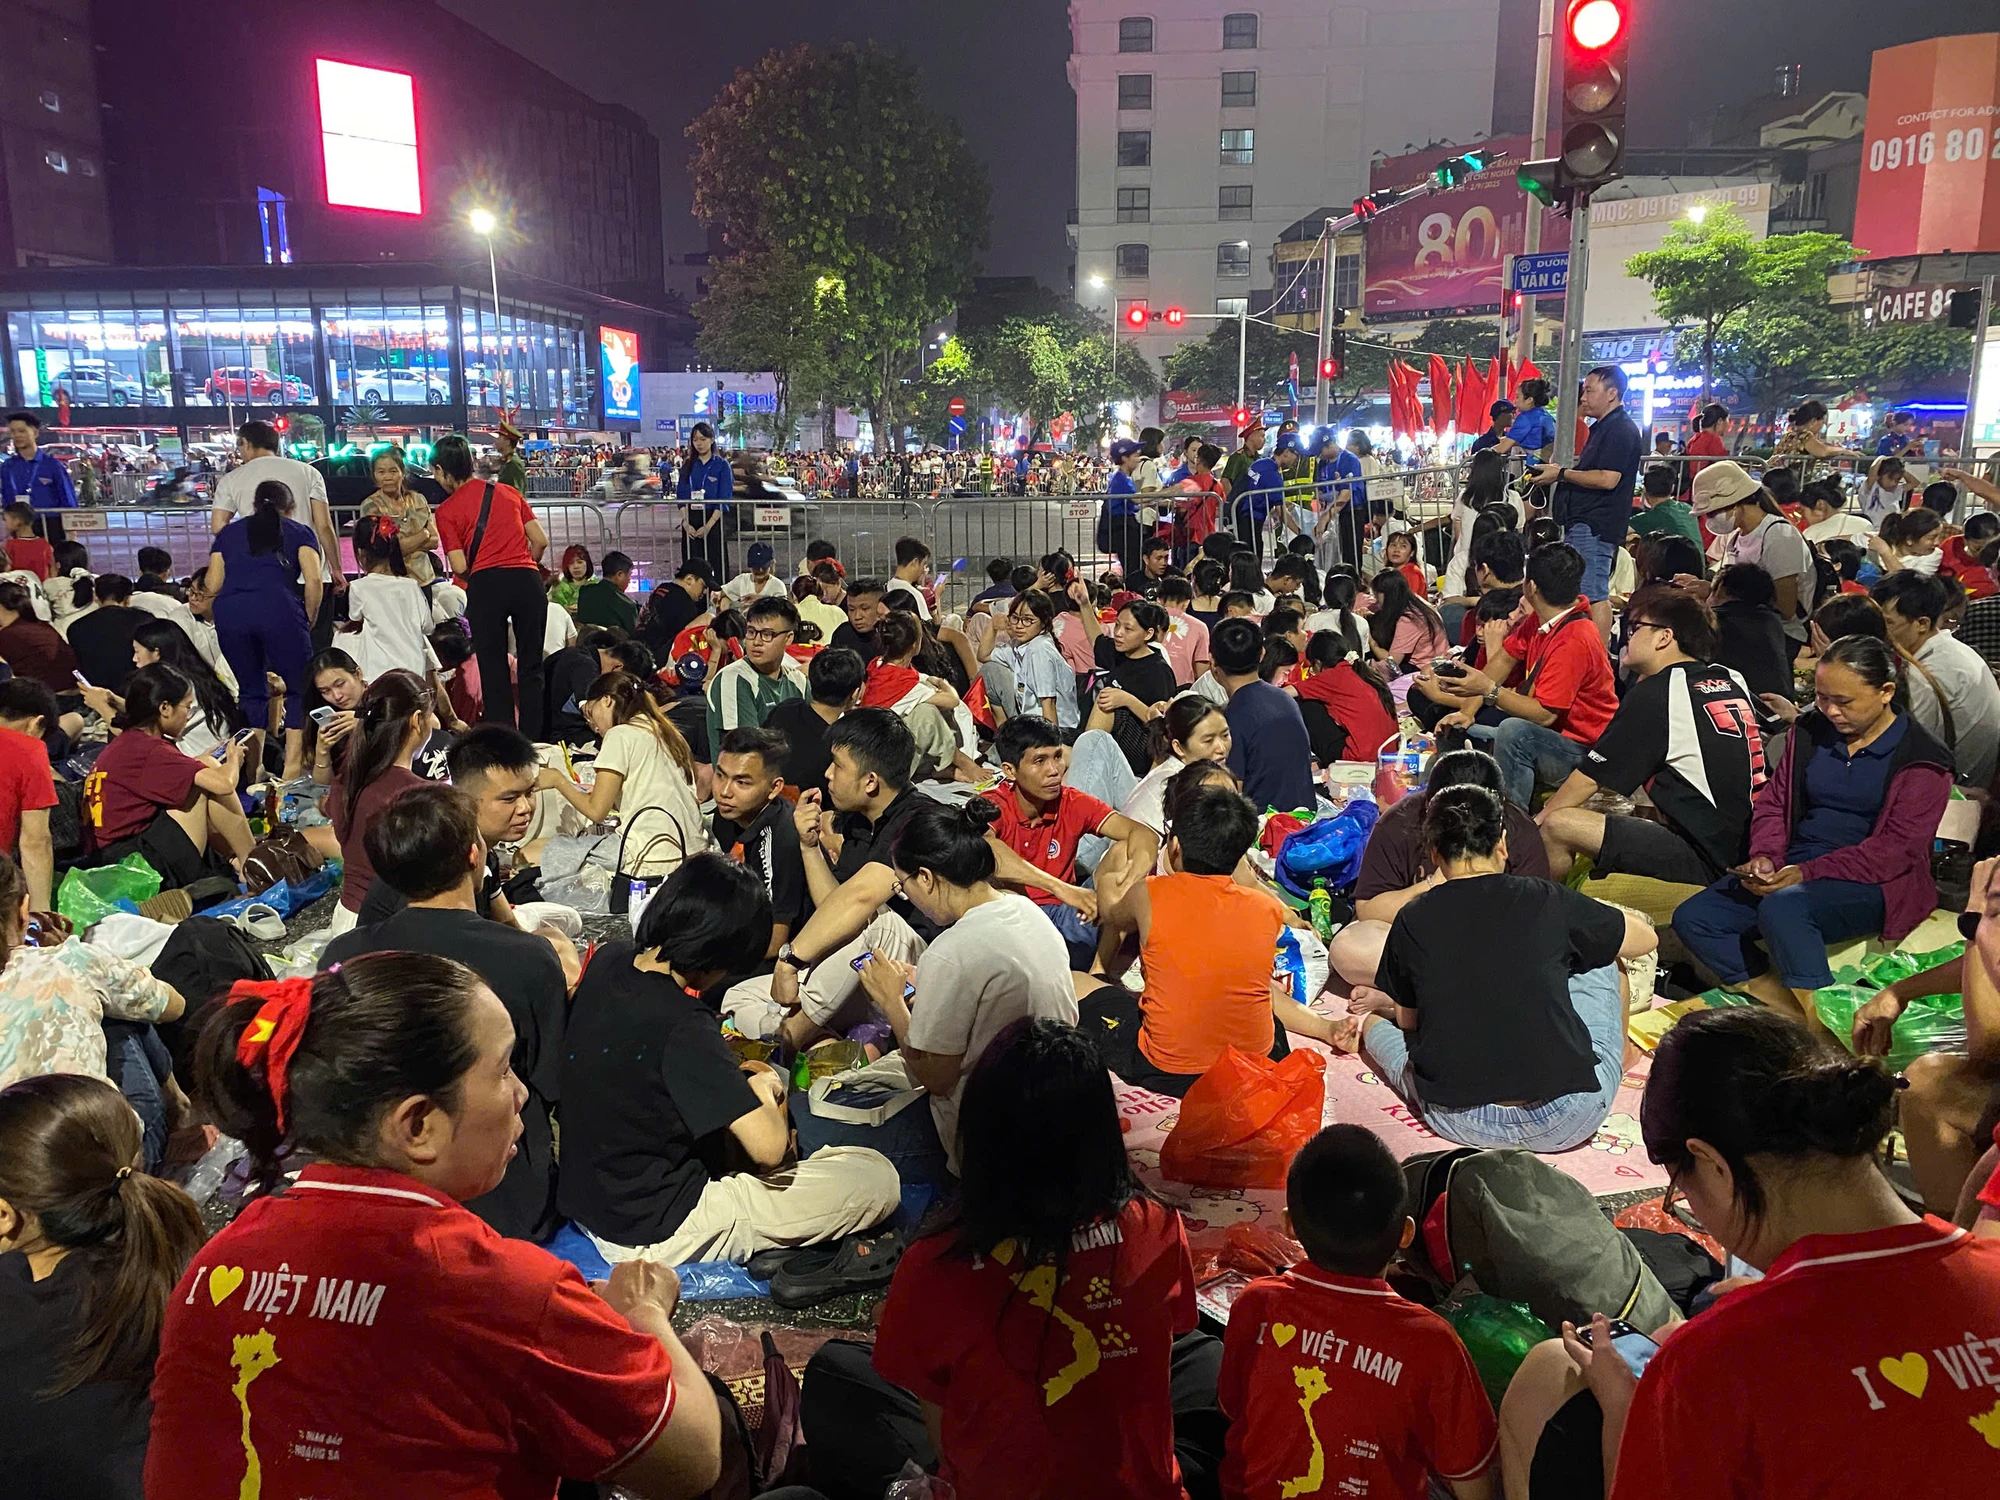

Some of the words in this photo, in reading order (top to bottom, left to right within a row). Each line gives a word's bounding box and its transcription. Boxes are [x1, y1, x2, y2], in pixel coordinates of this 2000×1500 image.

[1897, 109, 1948, 126] CONTACT
[1950, 106, 1975, 118] FOR
[1869, 131, 1936, 172] 0916
[1944, 127, 1984, 162] 80
[1737, 187, 1760, 206] 99
[1414, 205, 1500, 272] 80
[1521, 271, 1549, 288] VĂN
[1881, 291, 1926, 321] CAFE
[72, 520, 98, 528] STOP
[185, 1266, 207, 1305] I
[243, 1262, 308, 1323] VIỆT
[309, 1277, 387, 1326] NAM
[1256, 1322, 1268, 1345] I
[1301, 1329, 1349, 1365] VIỆT
[1352, 1344, 1404, 1387] NAM
[1851, 1366, 1886, 1411] I
